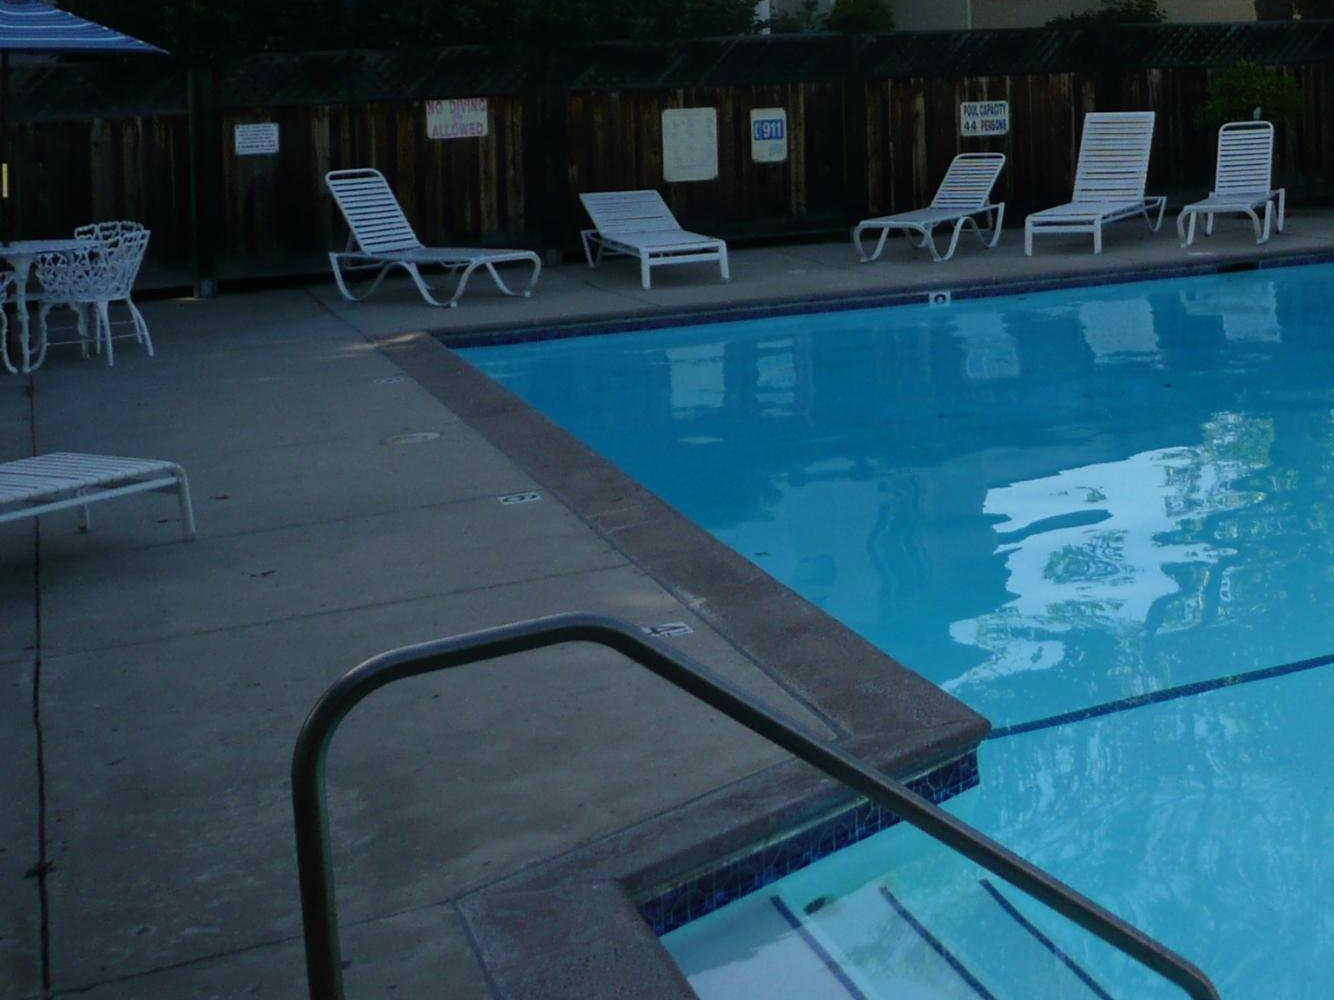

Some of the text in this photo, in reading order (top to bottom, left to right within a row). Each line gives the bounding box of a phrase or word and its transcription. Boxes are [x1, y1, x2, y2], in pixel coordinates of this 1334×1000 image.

[427, 98, 486, 115] NO DIVING
[963, 103, 1006, 115] POOL CAPACITY
[432, 122, 484, 137] ALLOWED
[763, 121, 782, 137] 911
[963, 119, 1006, 131] 44 PERSONS
